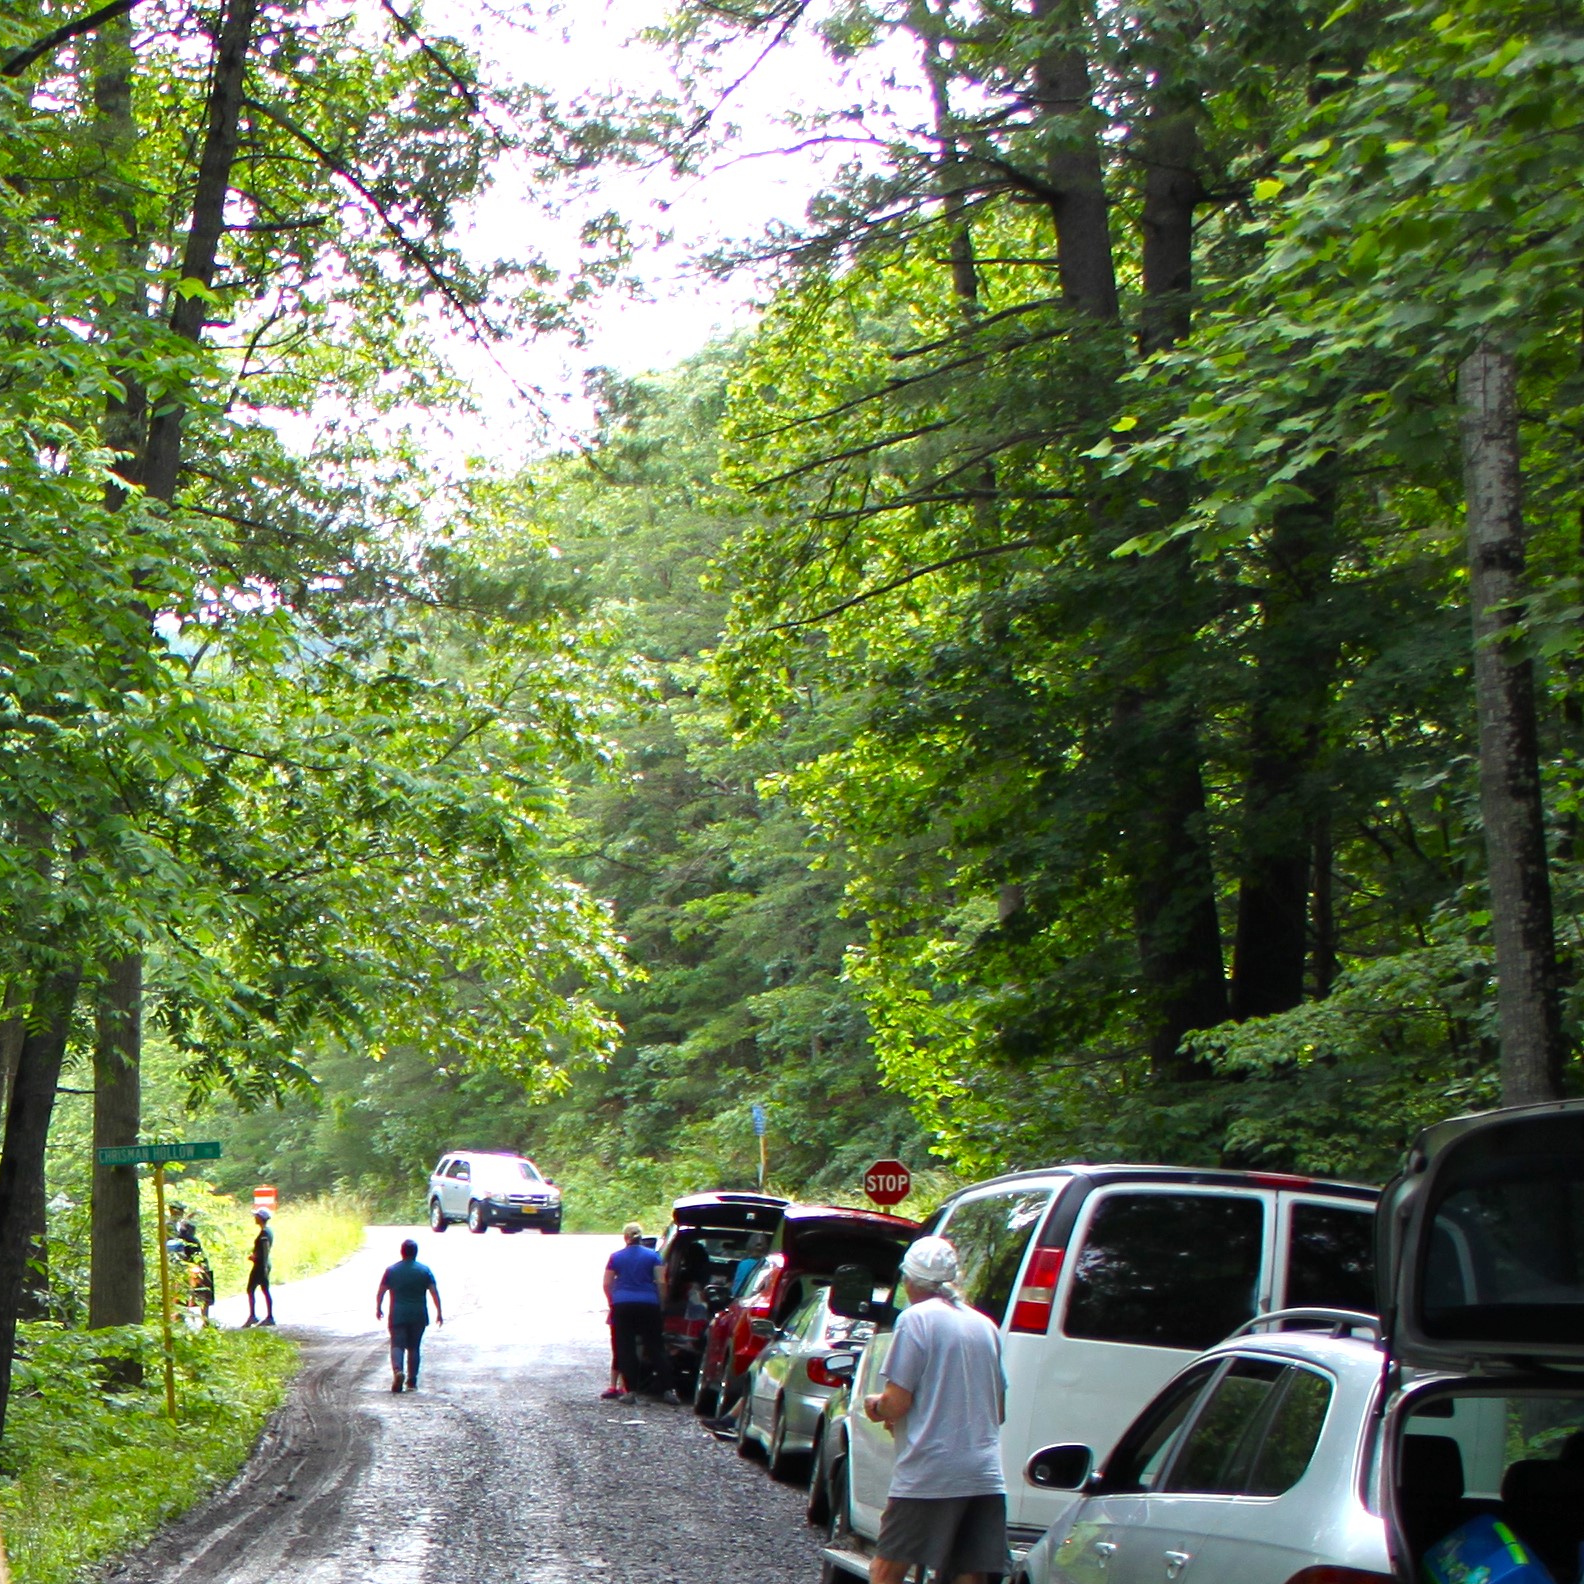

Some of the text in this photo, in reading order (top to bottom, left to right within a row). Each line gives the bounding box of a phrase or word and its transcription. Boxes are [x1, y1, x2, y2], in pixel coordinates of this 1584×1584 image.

[99, 1147, 149, 1163] CHRISMAN
[153, 1145, 195, 1160] HOLLOW
[867, 1175, 908, 1192] STOP
